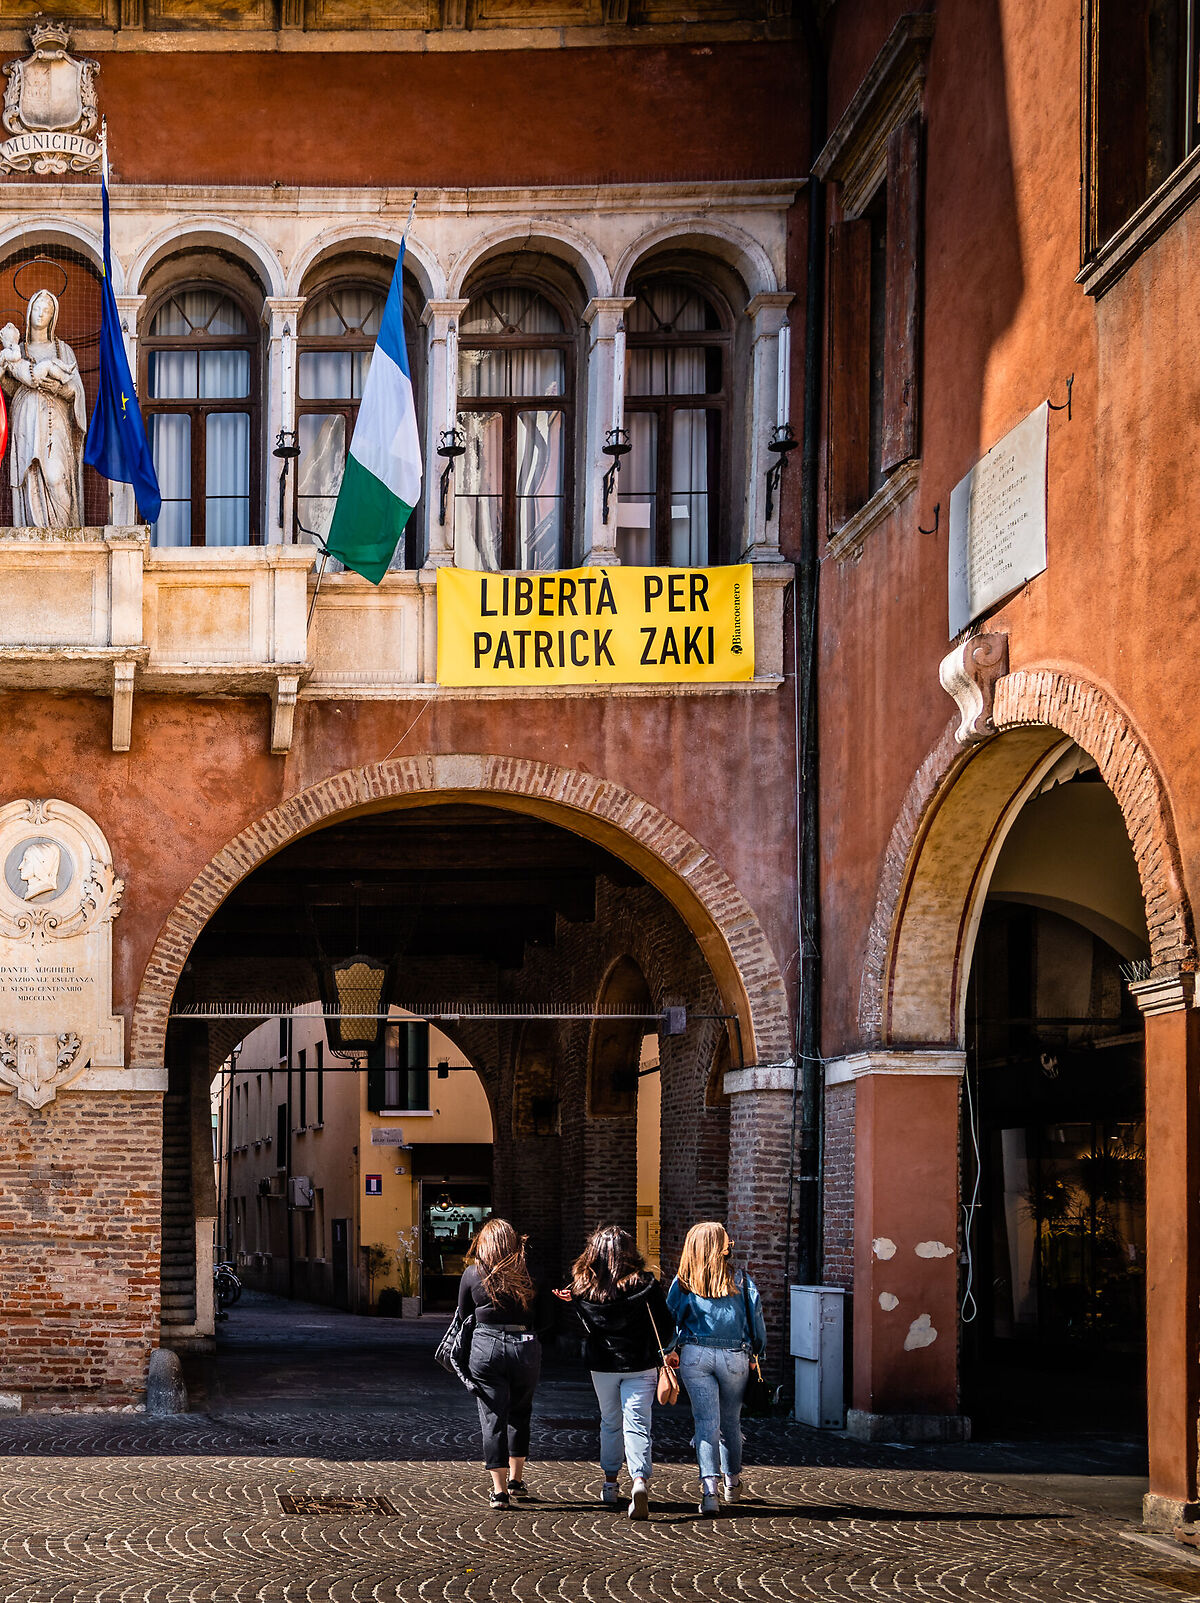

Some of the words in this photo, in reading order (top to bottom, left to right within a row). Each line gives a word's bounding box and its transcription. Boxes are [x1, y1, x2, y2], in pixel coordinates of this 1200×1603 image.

[6, 134, 96, 156] MUNICIPIO
[481, 569, 617, 616] LIBERTÀ
[644, 574, 709, 612] PER
[732, 583, 743, 646] Biancoenero
[474, 629, 615, 668] PATRICK
[641, 627, 714, 665] ZAKI
